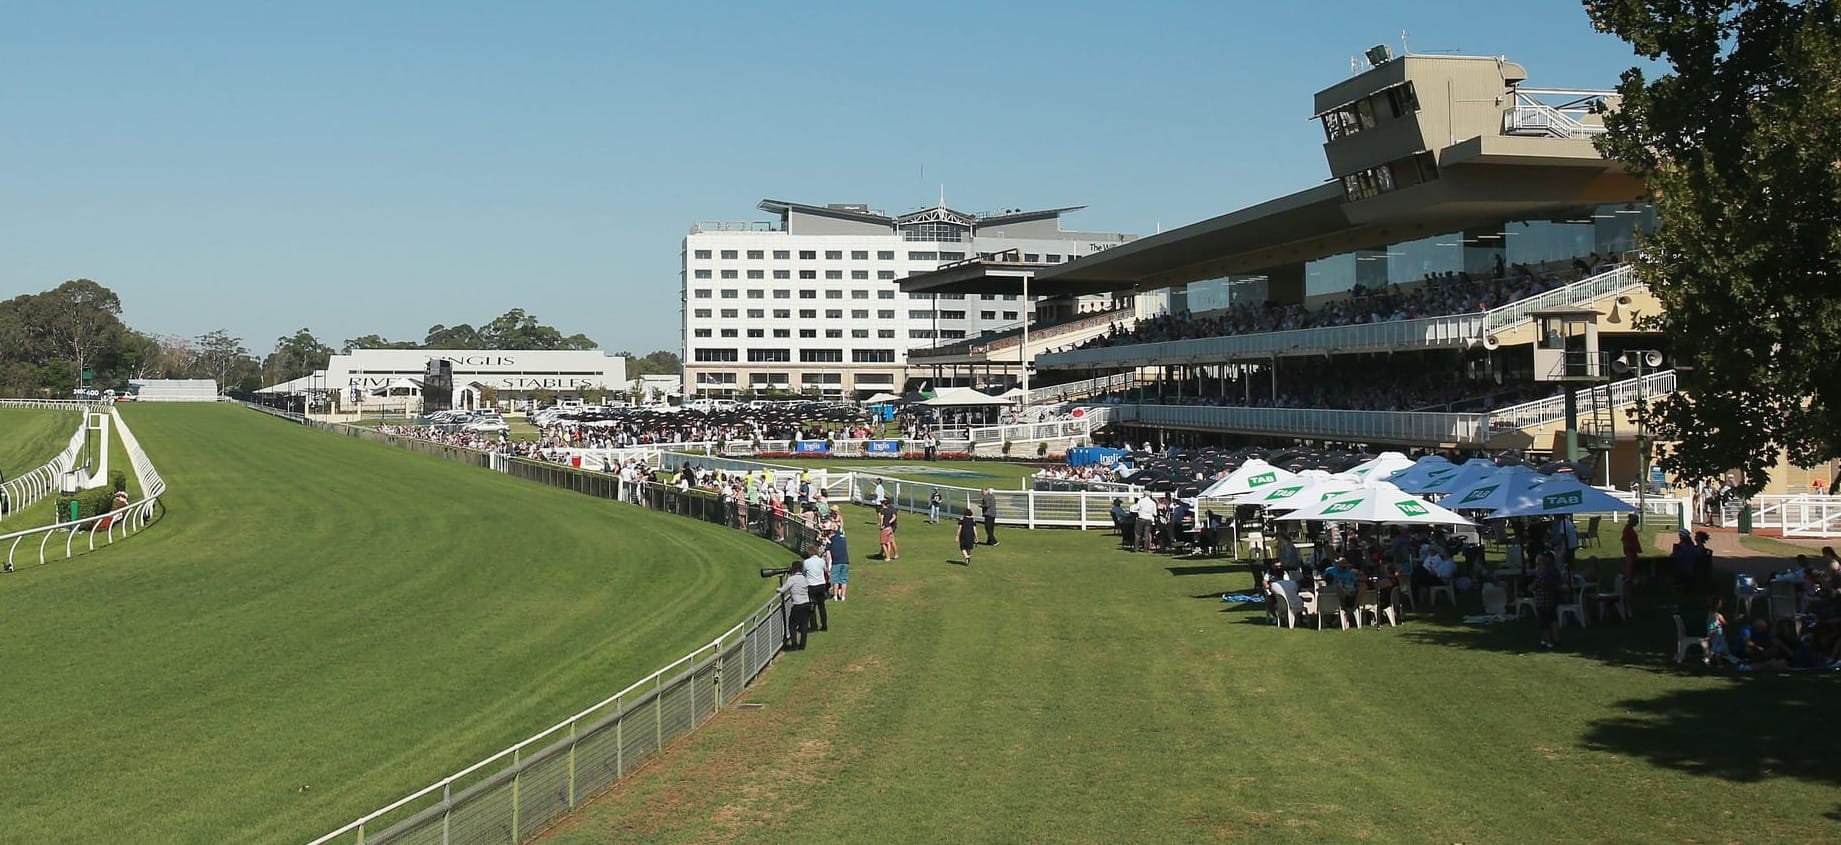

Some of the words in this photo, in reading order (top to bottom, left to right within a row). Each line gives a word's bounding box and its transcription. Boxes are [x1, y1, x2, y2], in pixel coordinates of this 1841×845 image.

[1089, 242, 1102, 252] The
[502, 378, 592, 388] STABLES
[803, 442, 820, 451] Inglis
[873, 442, 890, 451] Inglis
[1250, 475, 1274, 484] TAB
[1274, 489, 1296, 497] TAB
[1469, 490, 1491, 498] TAB
[1547, 496, 1579, 505] TAB
[1330, 503, 1354, 511] TAB
[1398, 504, 1426, 513] TAB
